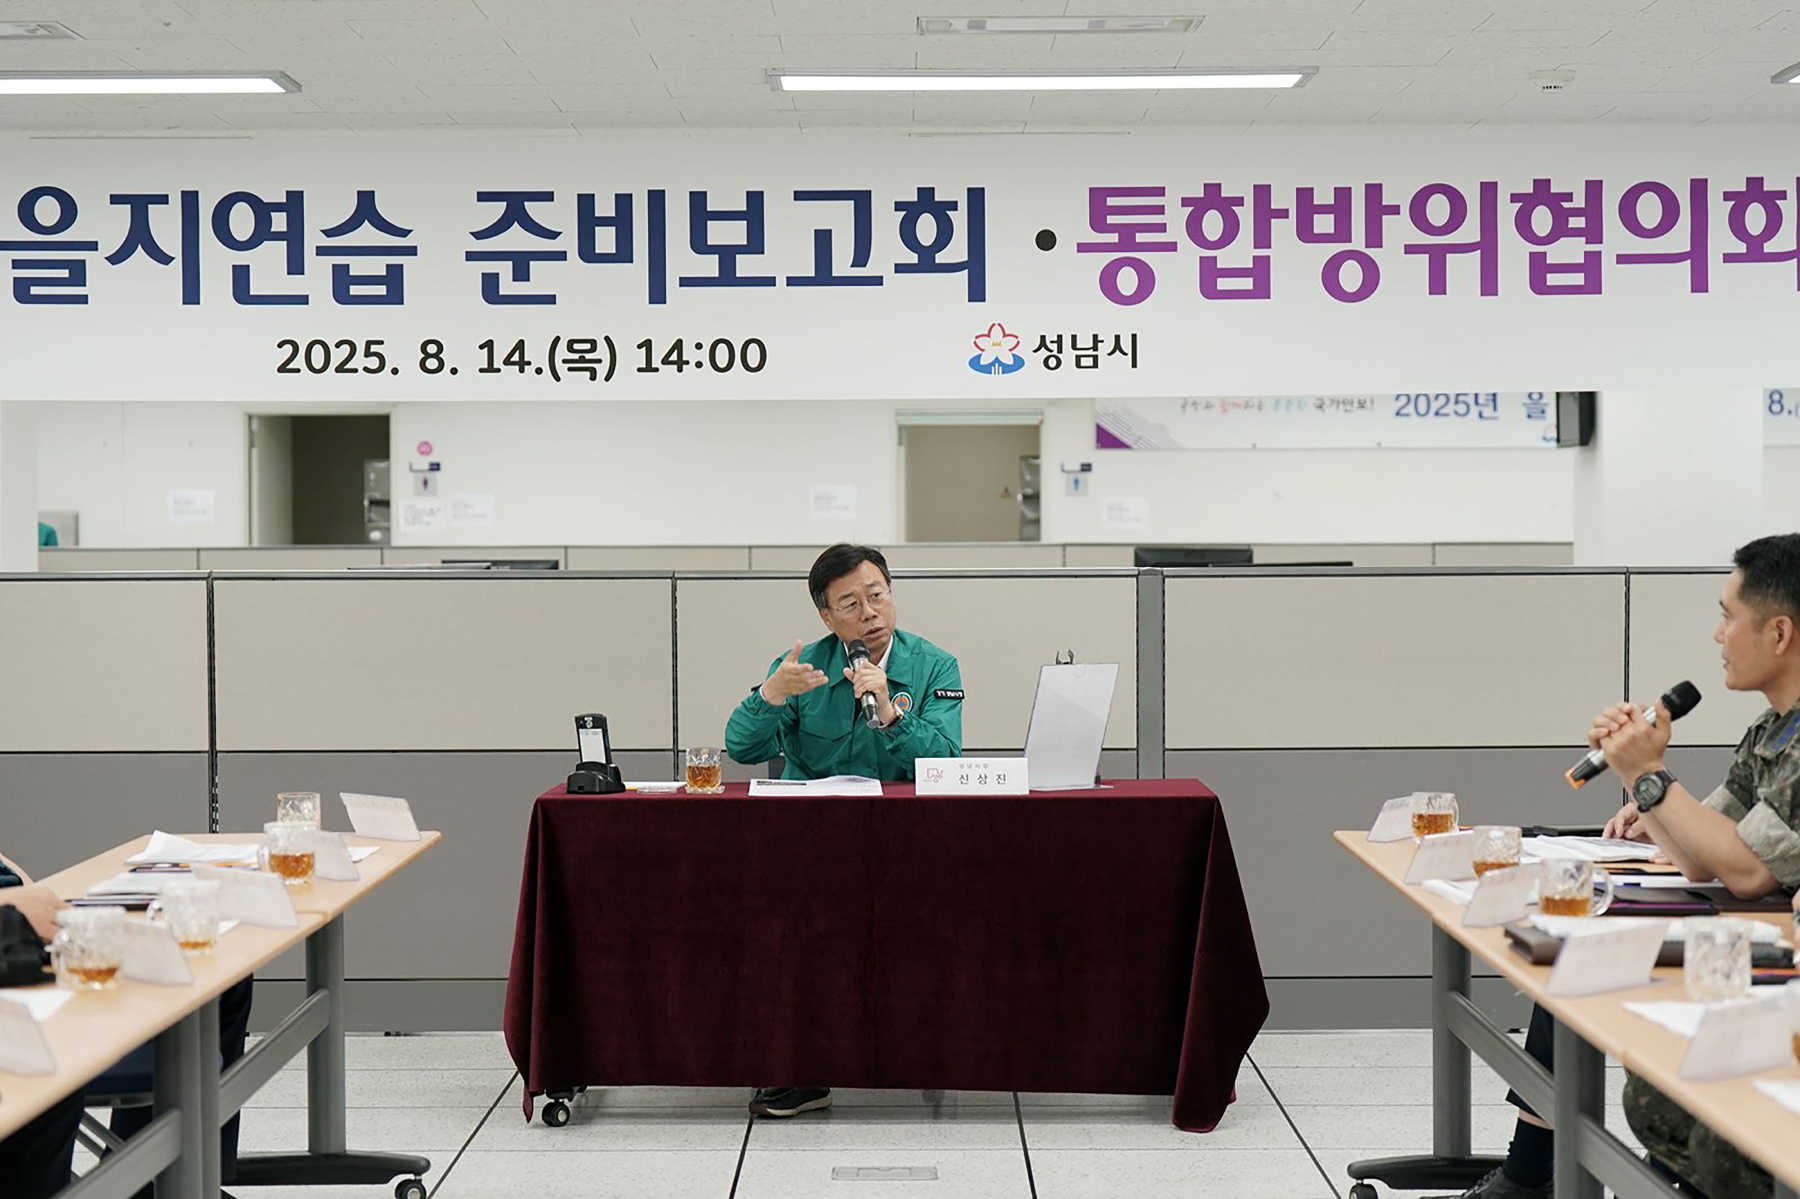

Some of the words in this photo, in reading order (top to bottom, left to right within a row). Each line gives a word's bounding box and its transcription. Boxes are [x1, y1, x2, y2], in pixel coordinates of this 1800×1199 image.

[0, 185, 418, 305] 을지연습
[465, 186, 987, 305] 준비보고회
[277, 338, 399, 375] 2025.
[419, 338, 458, 375] 8.
[478, 335, 617, 382] 14.(목)
[637, 337, 767, 374] 14:00
[1032, 332, 1138, 371] 성남시
[1394, 393, 1499, 420] 2025년
